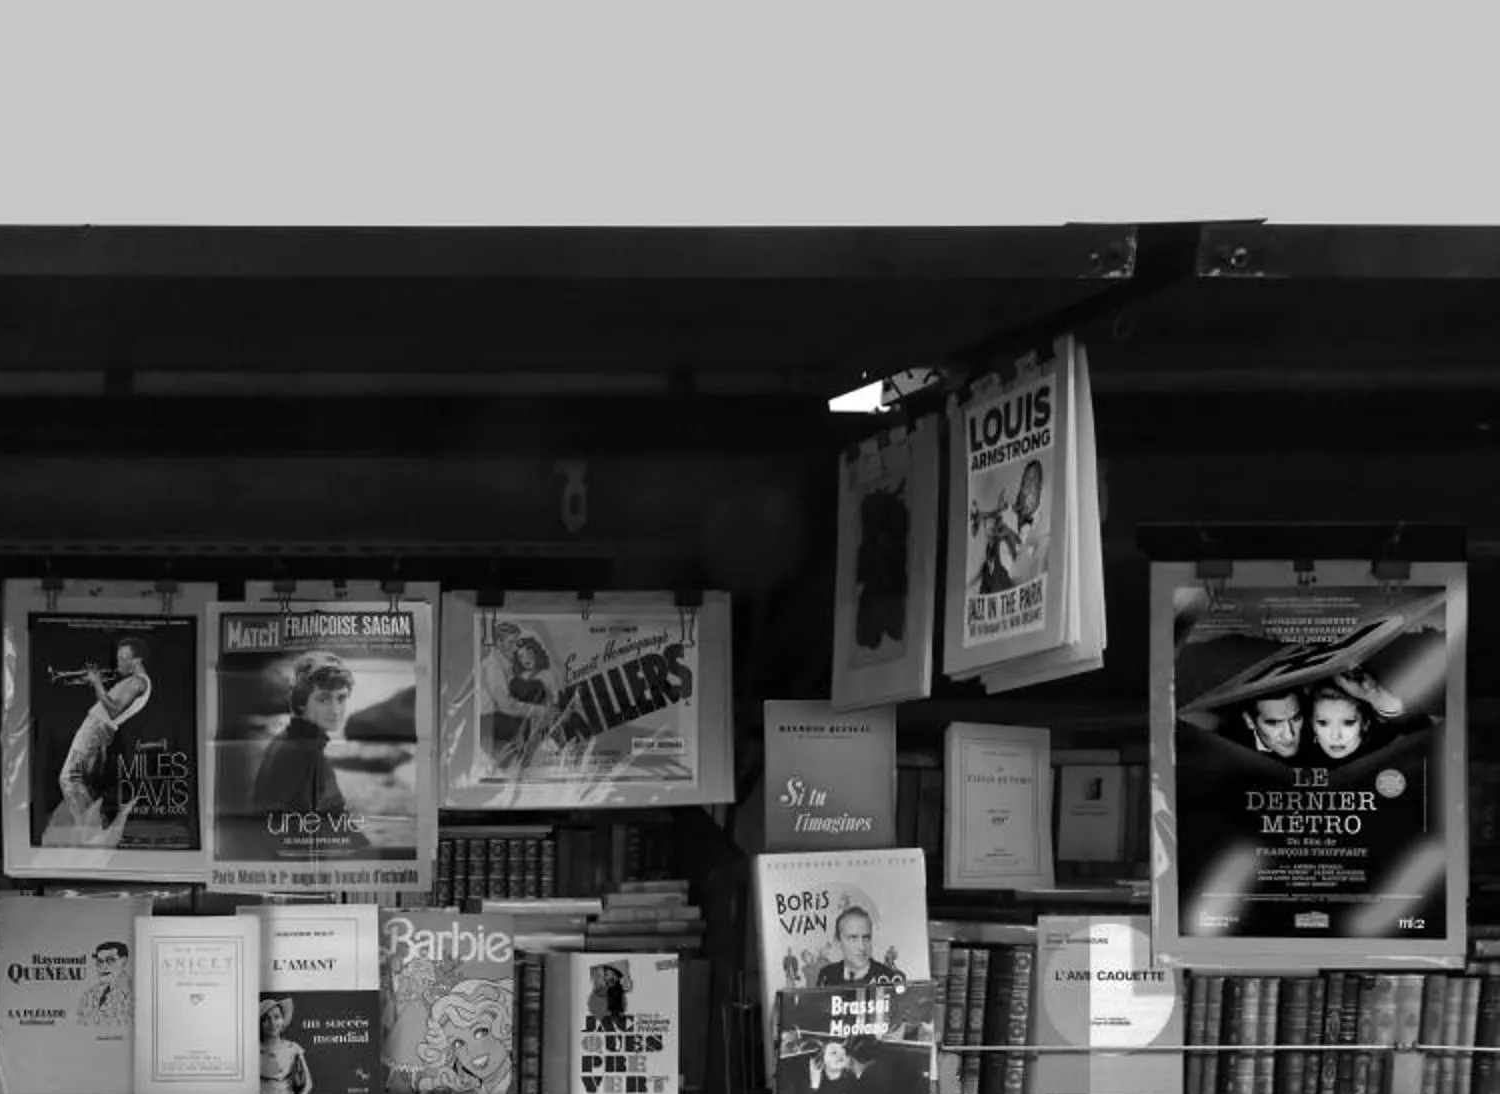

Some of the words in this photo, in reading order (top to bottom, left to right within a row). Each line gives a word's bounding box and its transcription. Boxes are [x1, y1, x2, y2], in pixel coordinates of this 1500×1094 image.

[969, 386, 1051, 452] LOUIS
[970, 429, 1052, 472] ARMSTRONG
[227, 620, 281, 648] MATCH
[363, 615, 411, 636] SAGAN
[551, 642, 693, 749] KILLERS
[117, 751, 189, 779] MILES
[1293, 767, 1329, 787] LE
[117, 779, 189, 807] DAVIS
[1245, 791, 1378, 811] DERNIER
[266, 811, 321, 835] une
[326, 811, 366, 833] vie
[1260, 809, 1363, 835] MÉTRO
[780, 914, 828, 936] VIAN
[383, 917, 513, 965] Barbie
[7, 963, 87, 985] QUENEAU
[273, 958, 337, 972] L'AMANT
